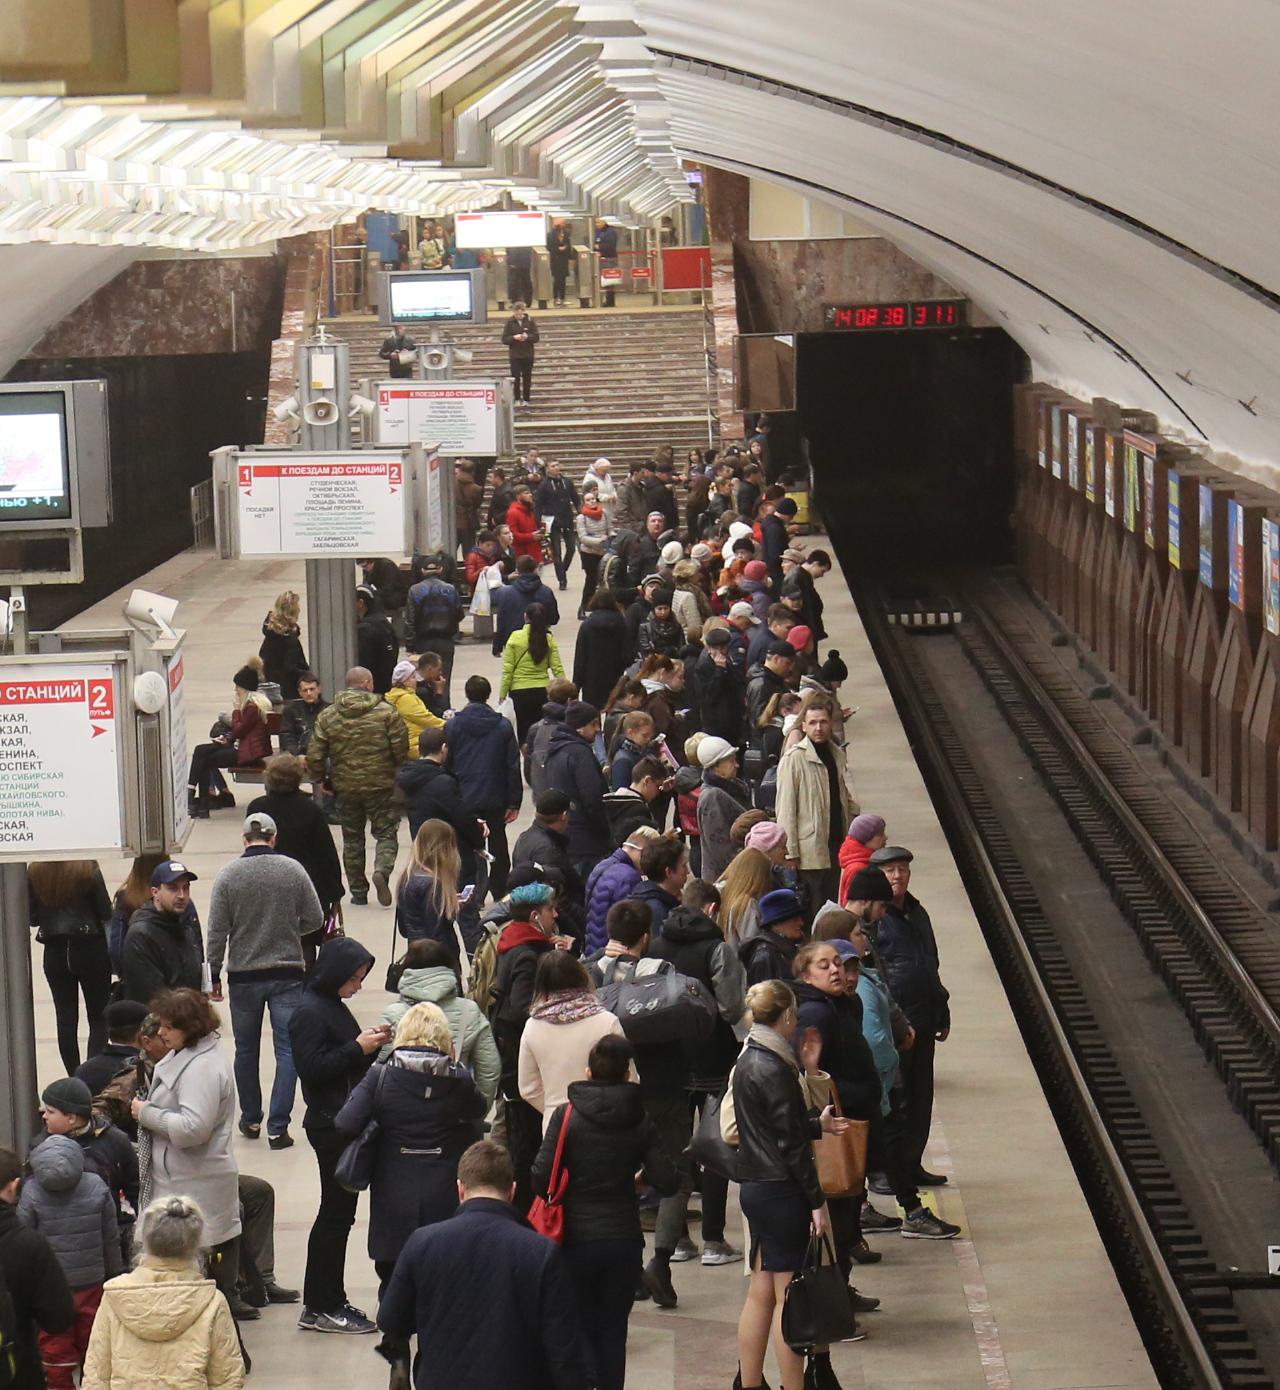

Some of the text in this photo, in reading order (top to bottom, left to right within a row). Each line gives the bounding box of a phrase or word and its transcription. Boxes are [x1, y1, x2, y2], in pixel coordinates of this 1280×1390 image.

[242, 468, 249, 480] 1
[288, 466, 330, 475] ПОЕЗДАМ
[331, 466, 344, 475] ДО
[345, 465, 386, 474] СТАНЦИЙ
[390, 467, 398, 479] 2
[6, 682, 82, 701] СТАНЦИЙ
[91, 685, 107, 708] 2
[11, 772, 64, 781] СИБИРСКАЯ
